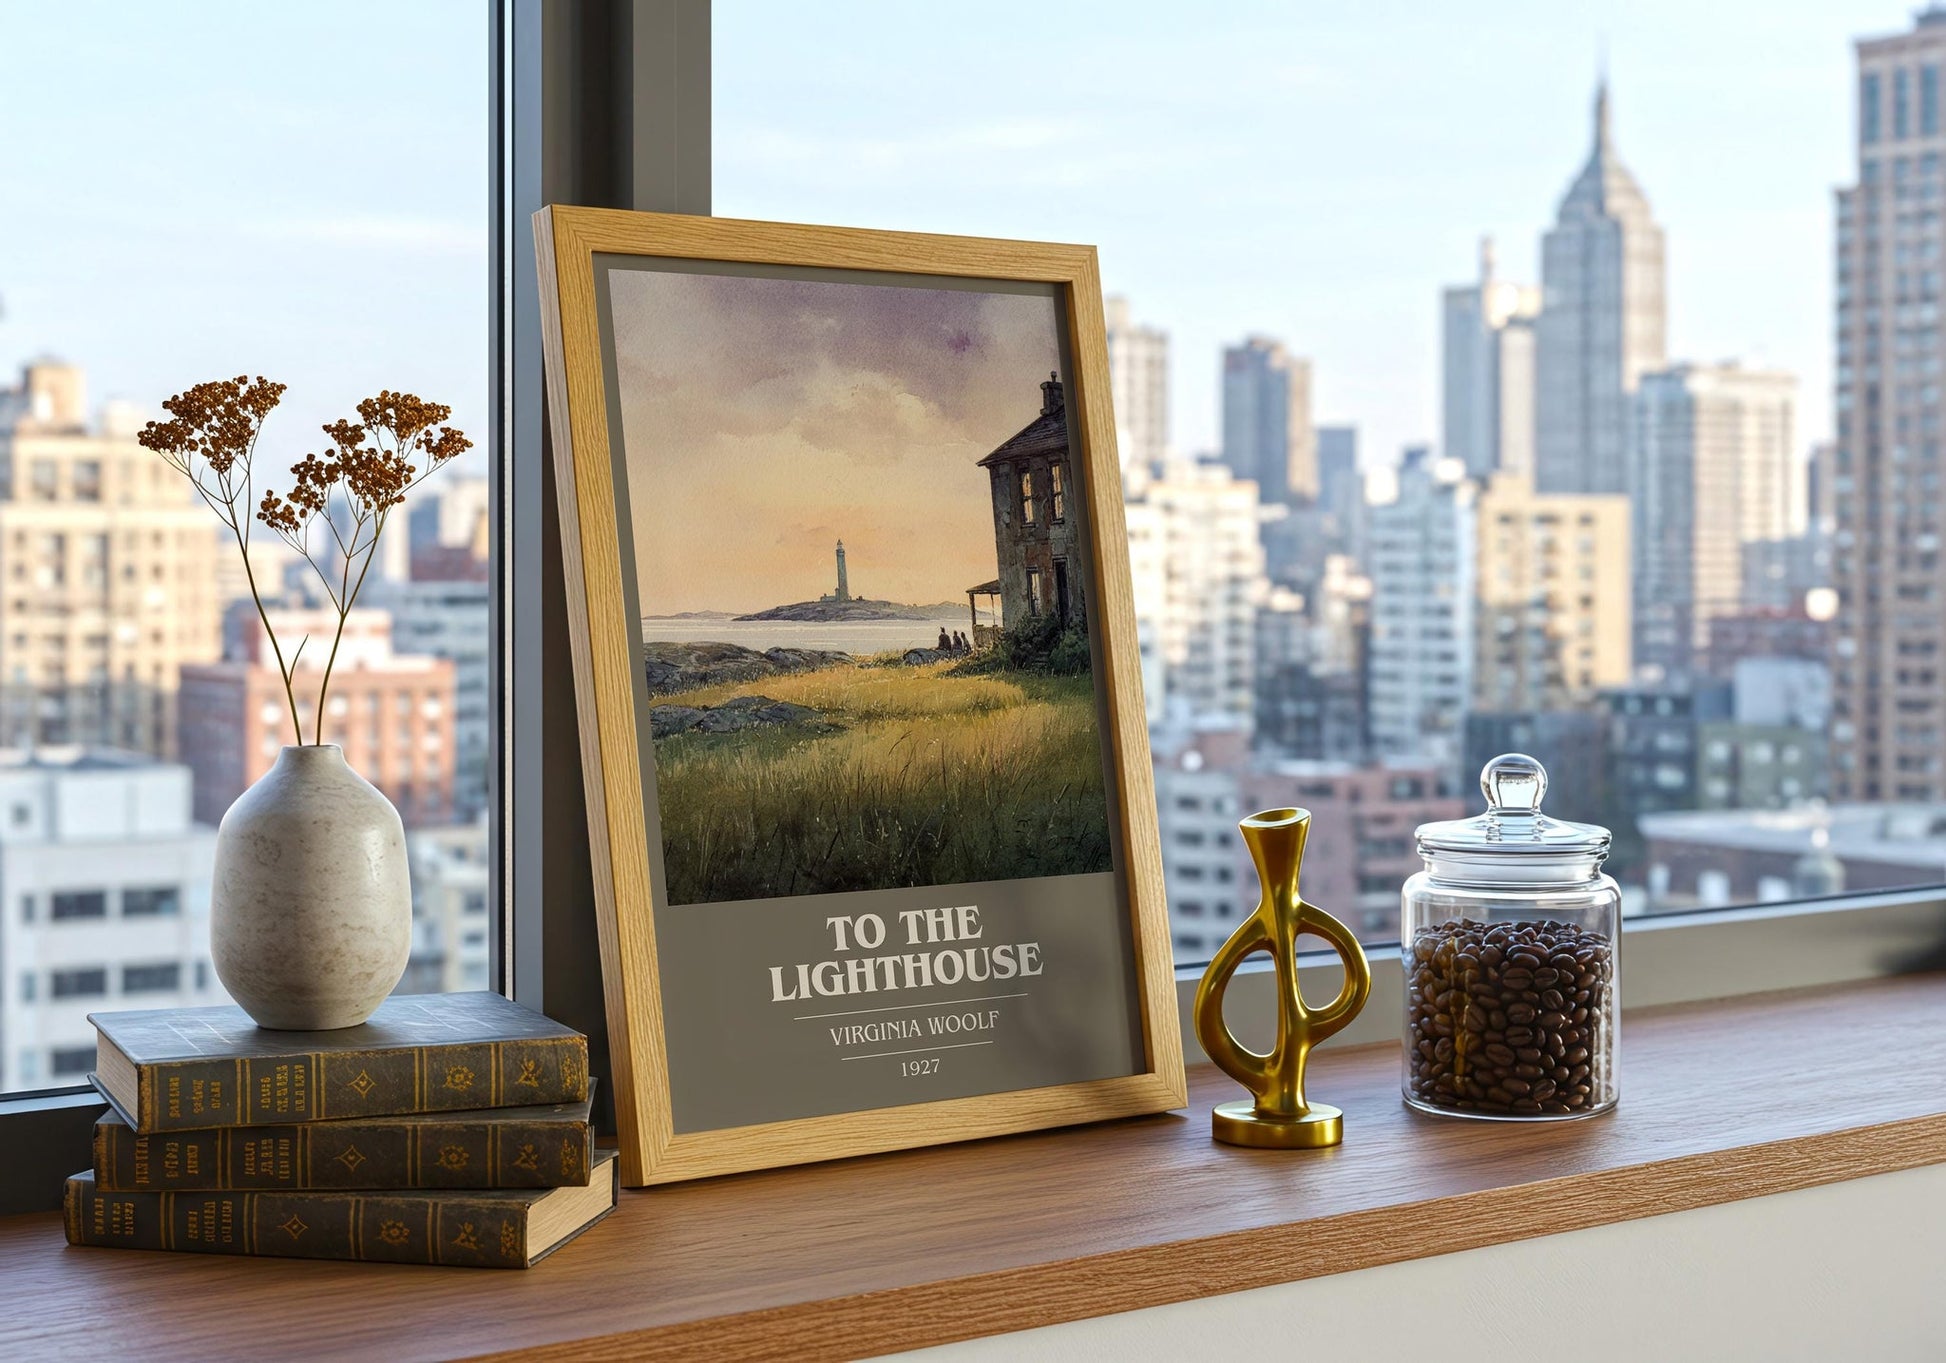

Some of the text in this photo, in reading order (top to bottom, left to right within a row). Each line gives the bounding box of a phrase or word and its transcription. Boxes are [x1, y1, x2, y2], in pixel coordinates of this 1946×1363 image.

[826, 905, 983, 951] TO THE
[768, 942, 1044, 1002] LIGHTHOUSE
[829, 1010, 1000, 1046] VIRGINIA WOOLF
[901, 1058, 941, 1077] 1927
